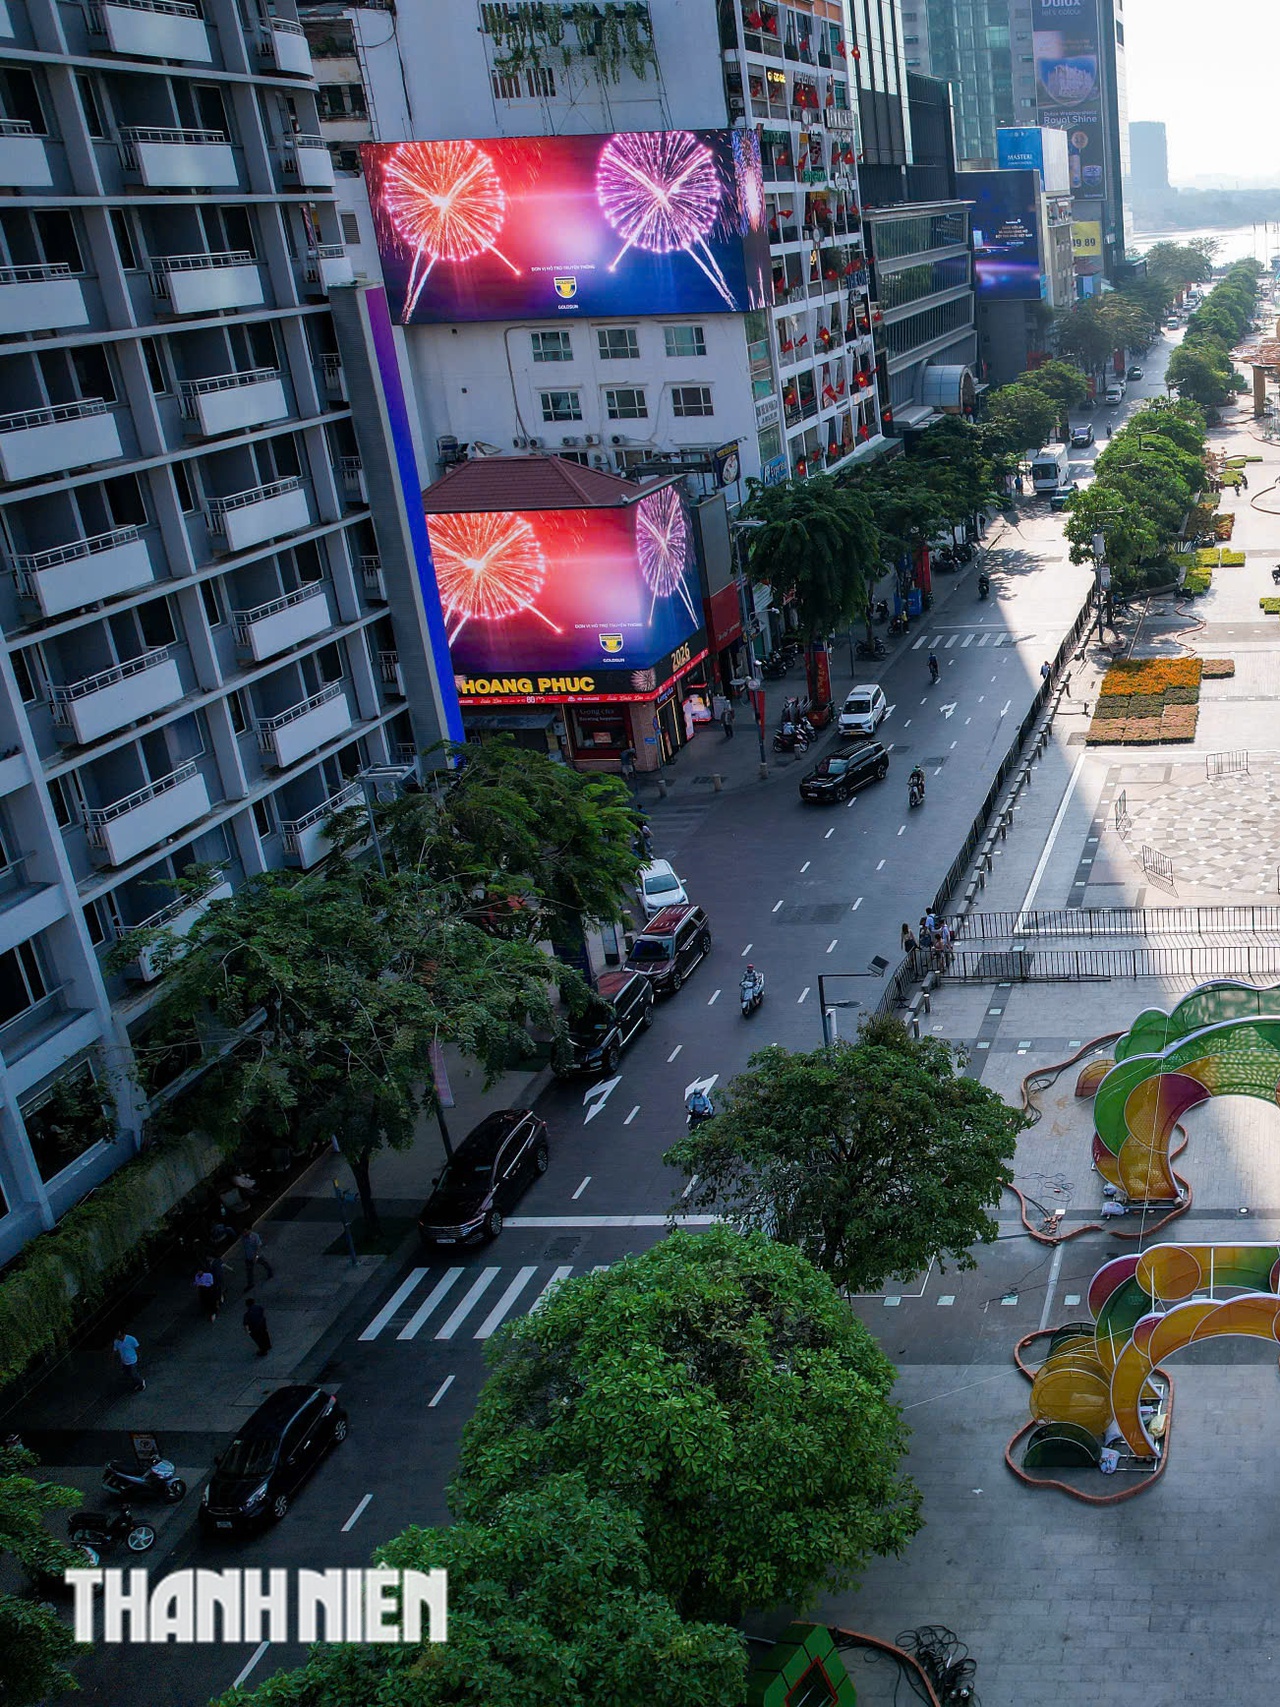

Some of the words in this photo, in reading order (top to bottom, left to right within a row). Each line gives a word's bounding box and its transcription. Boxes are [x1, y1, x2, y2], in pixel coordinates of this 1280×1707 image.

[1044, 116, 1070, 124] Royal
[671, 642, 690, 671] 2026
[461, 678, 534, 694] HOANG
[538, 676, 596, 692] PHUC
